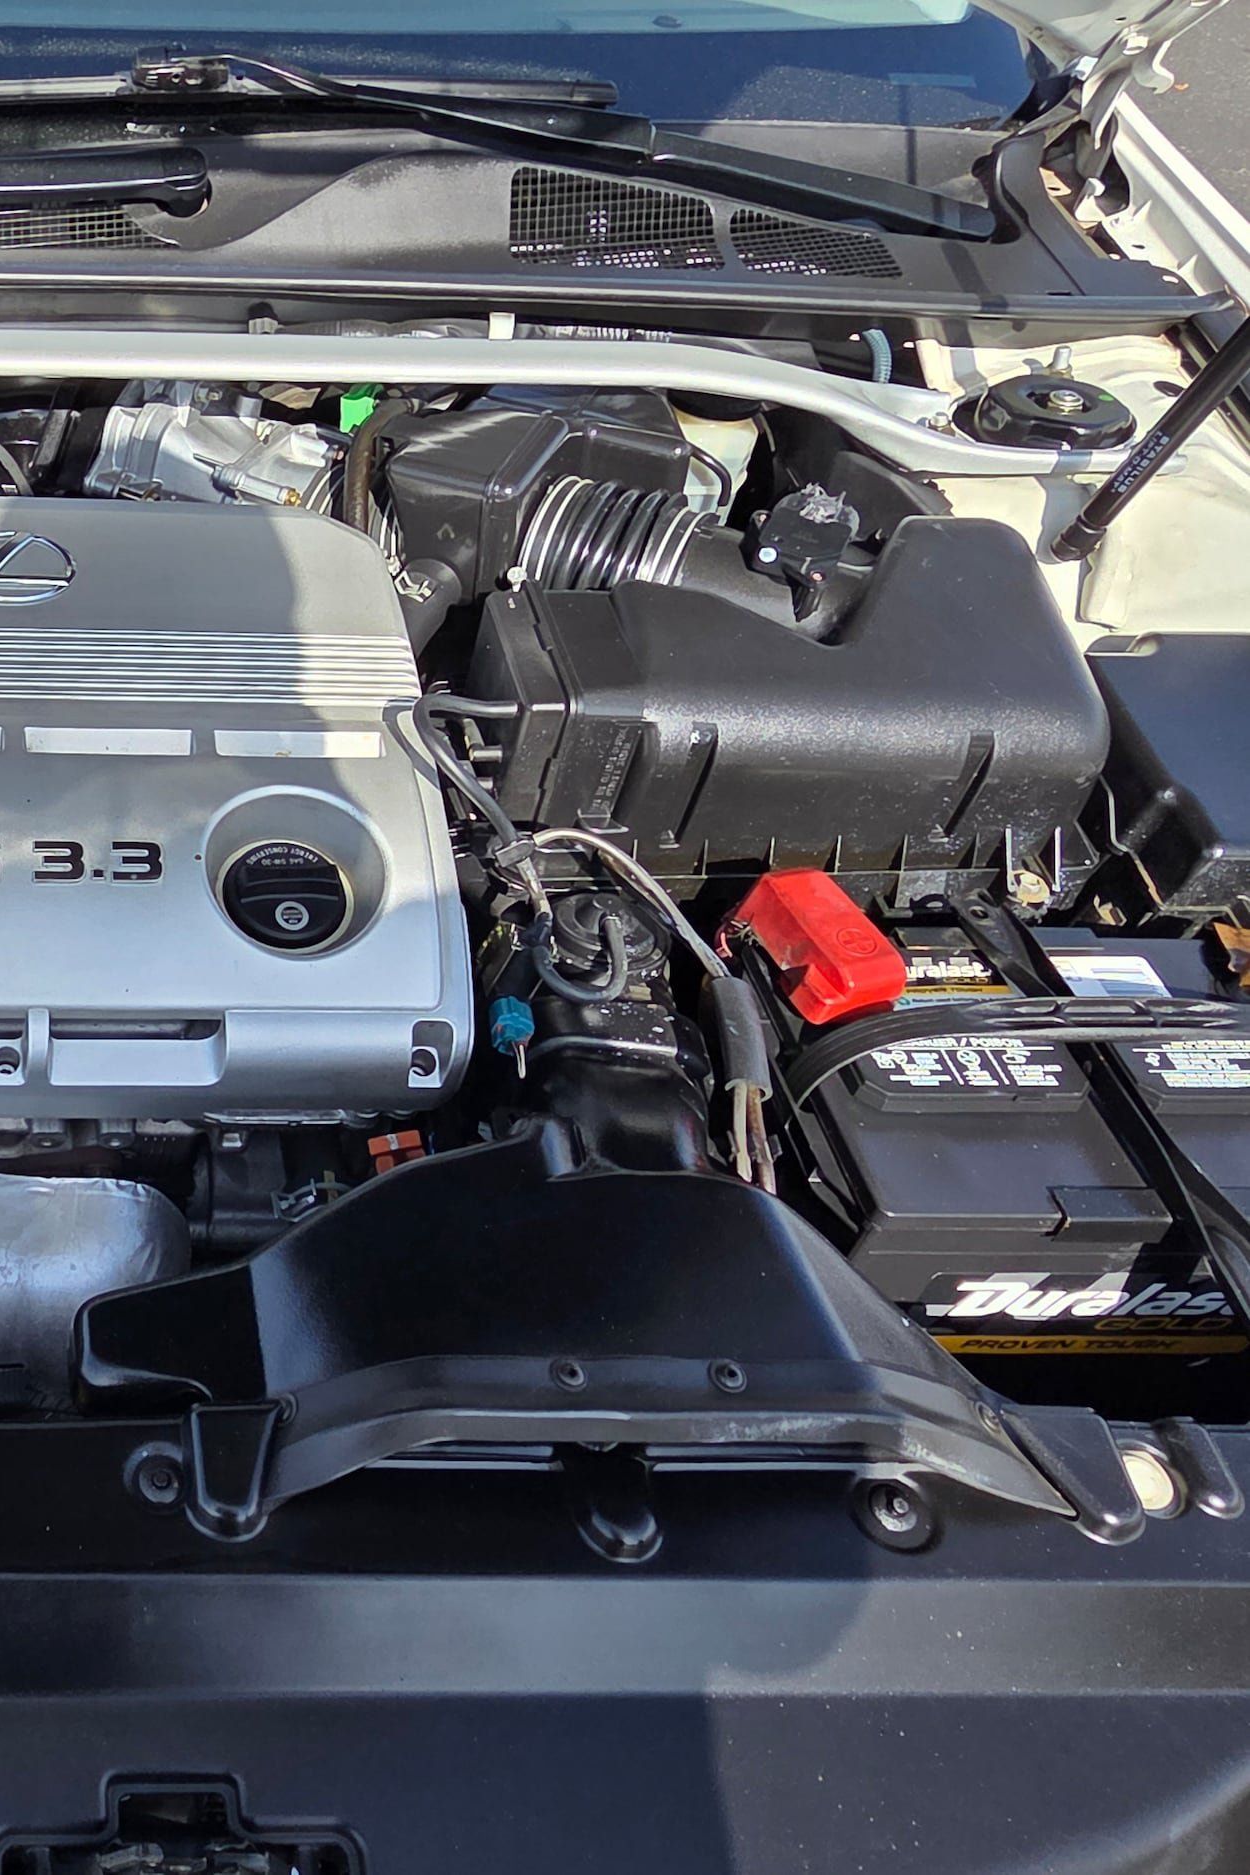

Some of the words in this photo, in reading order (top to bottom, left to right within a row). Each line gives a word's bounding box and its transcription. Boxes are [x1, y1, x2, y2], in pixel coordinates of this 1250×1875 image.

[1117, 435, 1170, 493] STABILUS
[32, 840, 164, 883] 3.3
[905, 961, 992, 979] uralast
[948, 1281, 1235, 1318] Duralas
[1093, 1317, 1232, 1331] GOLD
[960, 1338, 1075, 1350] PROVEN
[1084, 1338, 1179, 1349] TOUGH
